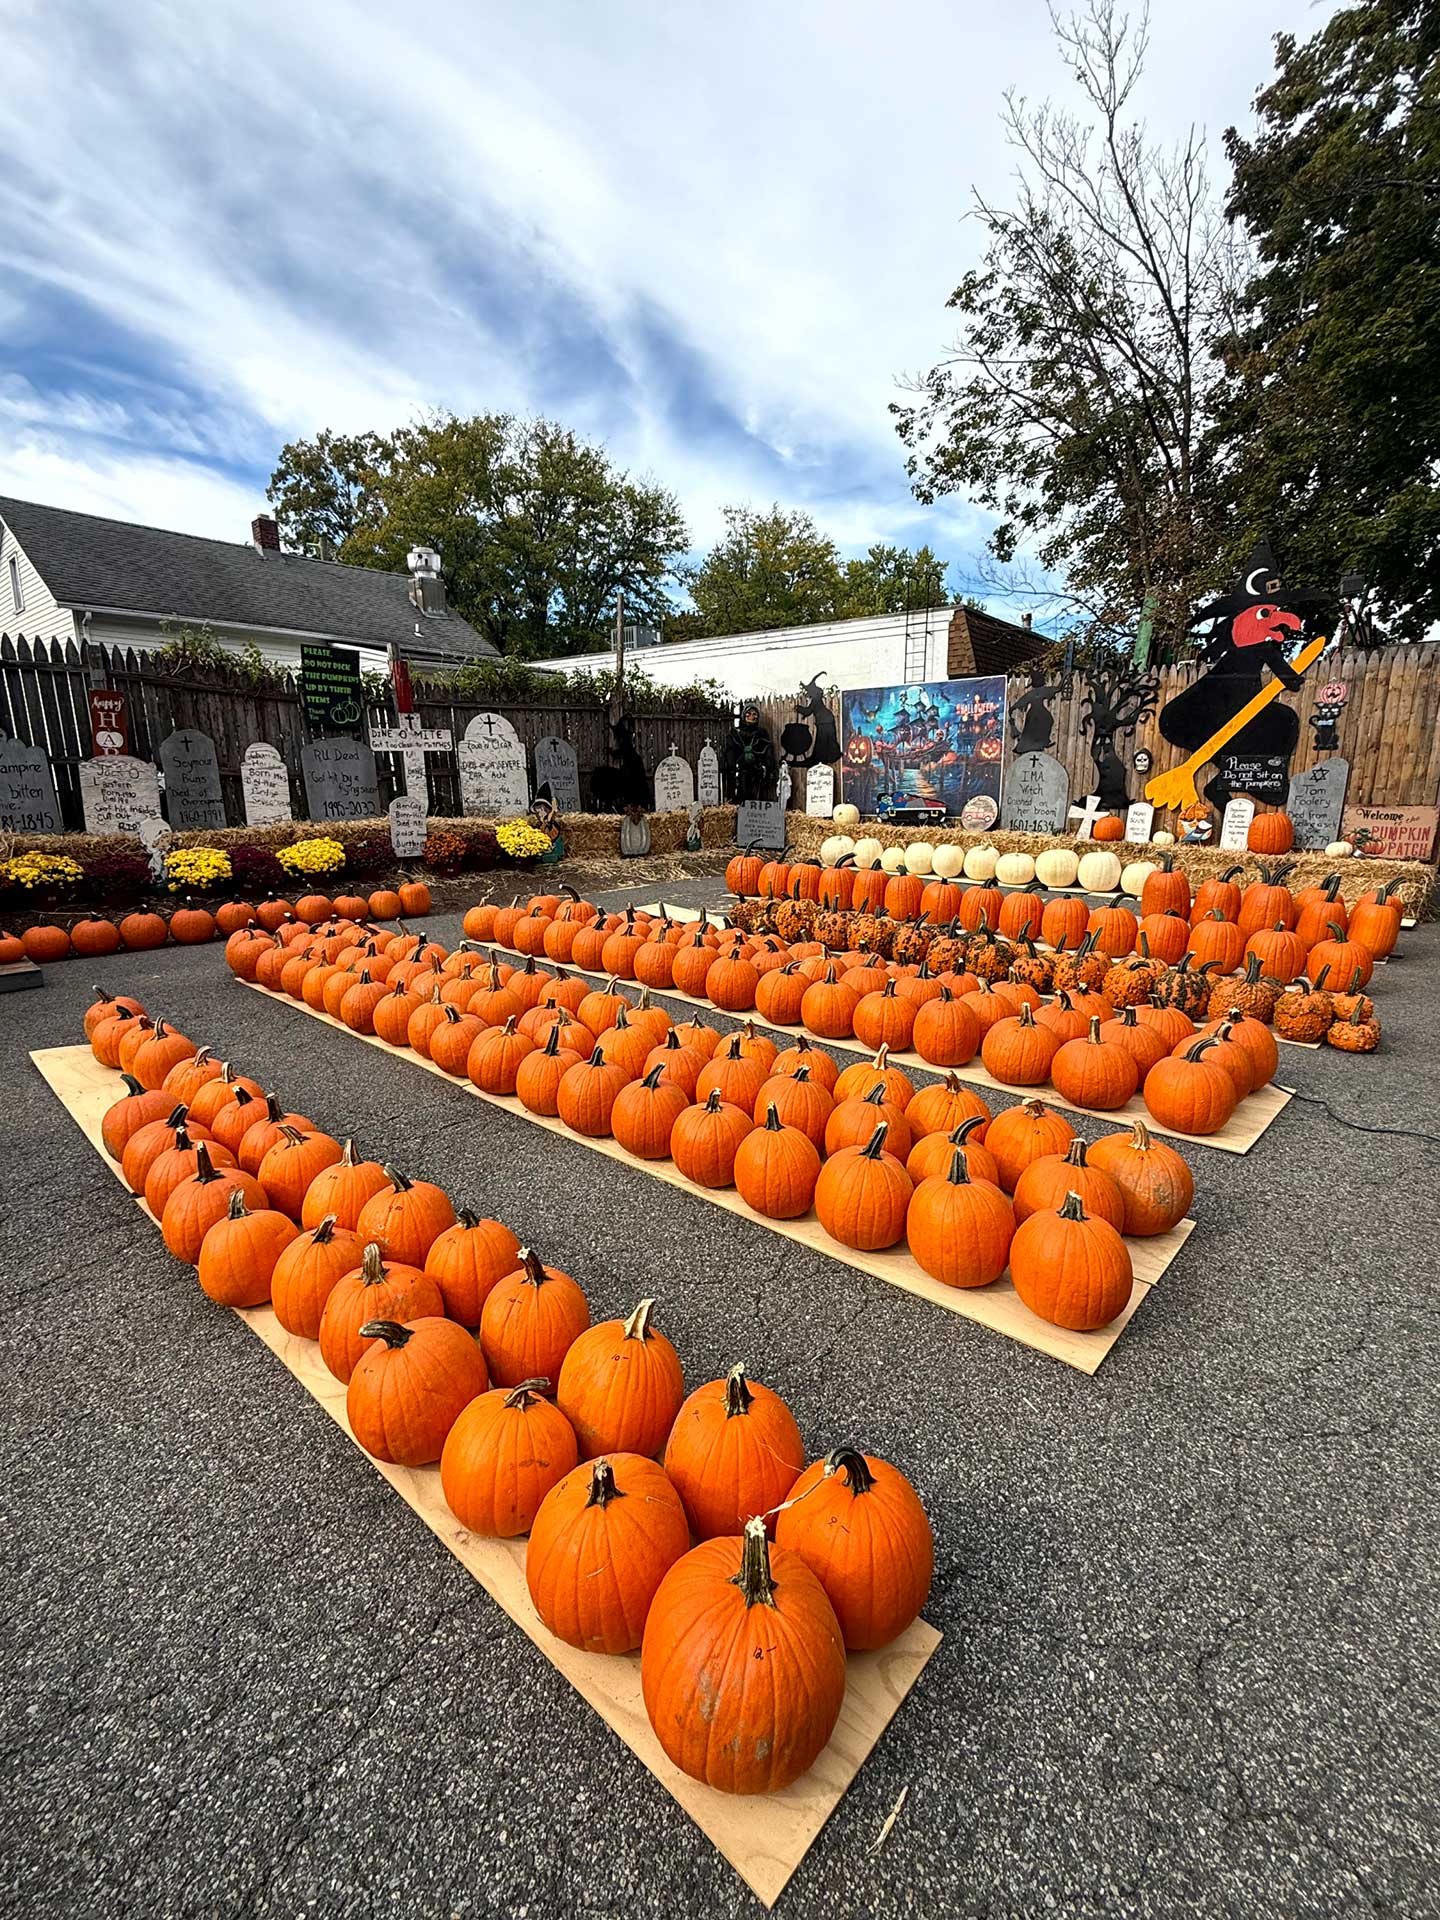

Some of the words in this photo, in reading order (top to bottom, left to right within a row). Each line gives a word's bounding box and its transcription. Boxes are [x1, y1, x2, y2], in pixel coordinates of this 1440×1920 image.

[304, 660, 316, 668] DO
[317, 661, 333, 669] NOT
[333, 663, 352, 671] PICK
[305, 672, 320, 680] THE
[321, 674, 359, 684] PUMPKINS
[329, 686, 351, 694] THEIR
[306, 696, 330, 704] STEMS
[314, 749, 330, 761] RU
[334, 747, 360, 761] Dead
[0, 760, 42, 778] ampire
[173, 756, 213, 773] Seymour
[1225, 756, 1263, 771] Please
[1223, 770, 1237, 779] Do
[1239, 770, 1253, 779] not
[1257, 770, 1270, 779] sit
[1019, 783, 1043, 796] Witch
[1229, 780, 1242, 788] the
[1245, 780, 1281, 791] pumpkins
[1303, 784, 1326, 796] Tom
[8, 784, 43, 801] bitten
[750, 801, 772, 811] RIP
[1294, 796, 1331, 808] Foolery
[1308, 809, 1328, 821] from
[1356, 808, 1405, 821] Welcome
[1009, 818, 1055, 832] 1601-1634
[1371, 826, 1431, 842] PUMPKIN
[1387, 841, 1428, 857] PATCH
